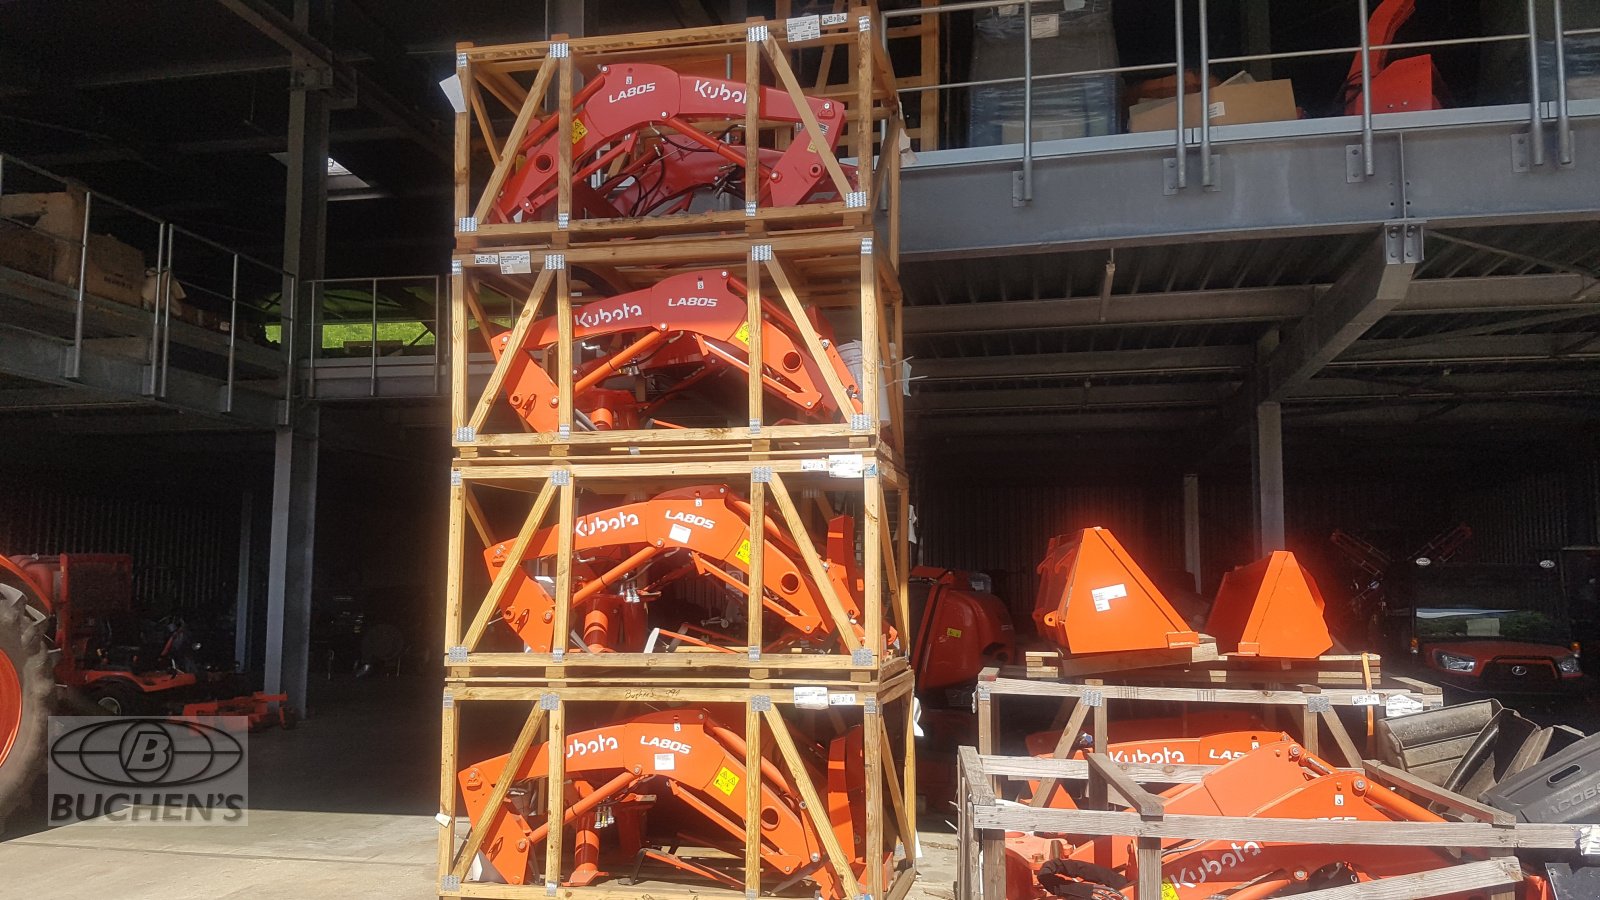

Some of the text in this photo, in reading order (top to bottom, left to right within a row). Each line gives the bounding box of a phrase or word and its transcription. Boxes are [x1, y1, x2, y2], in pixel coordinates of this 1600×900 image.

[609, 82, 656, 104] LA805
[694, 79, 747, 105] Kubo
[668, 297, 718, 307] LA805
[575, 303, 643, 328] Kubota
[665, 510, 716, 529] LA805
[563, 734, 618, 758] ubota
[640, 735, 692, 755] LA805
[1170, 841, 1261, 889] Kubota
